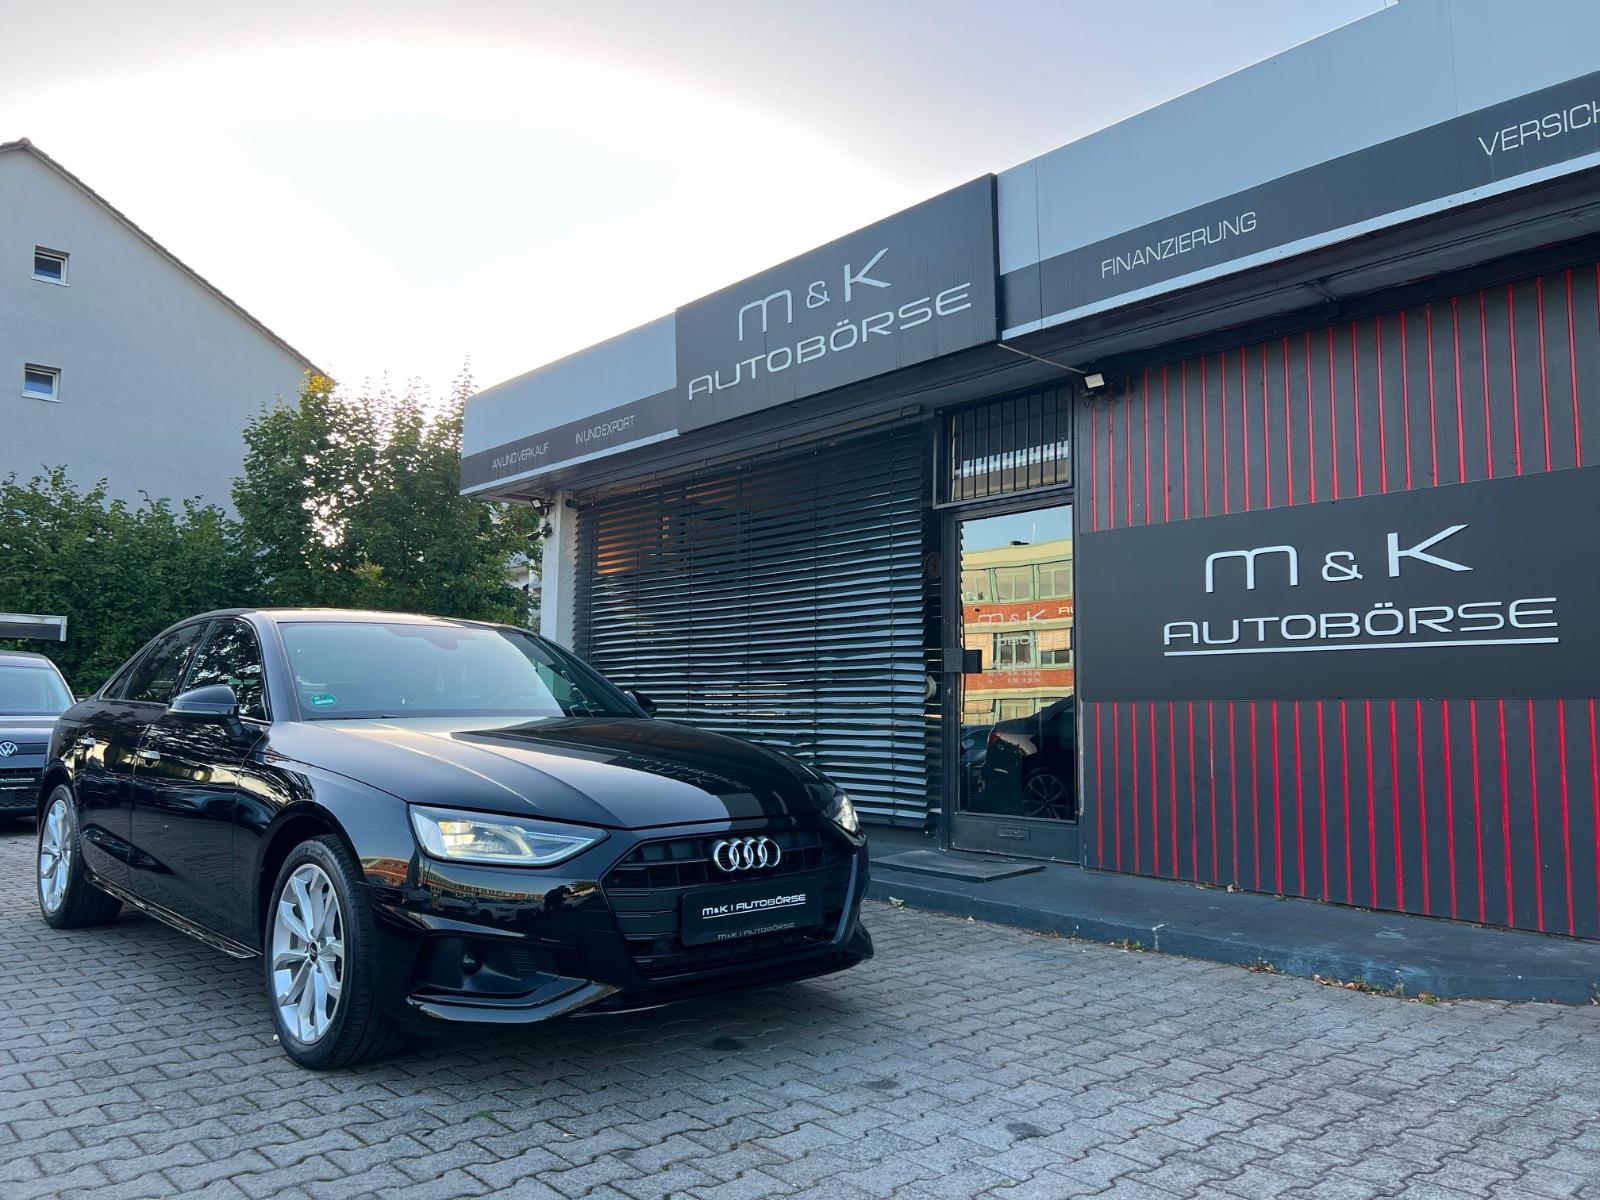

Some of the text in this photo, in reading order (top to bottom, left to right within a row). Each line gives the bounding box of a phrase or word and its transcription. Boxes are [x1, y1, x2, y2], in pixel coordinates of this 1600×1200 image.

[1101, 211, 1257, 279] FINANZIERUNG
[738, 247, 892, 341] M & K
[688, 282, 972, 401] AUTOBÖRSE
[1205, 524, 1475, 593] M & K
[1163, 597, 1559, 646] AUTOBÖRSE
[735, 893, 806, 911] AUTOBÖRSE
